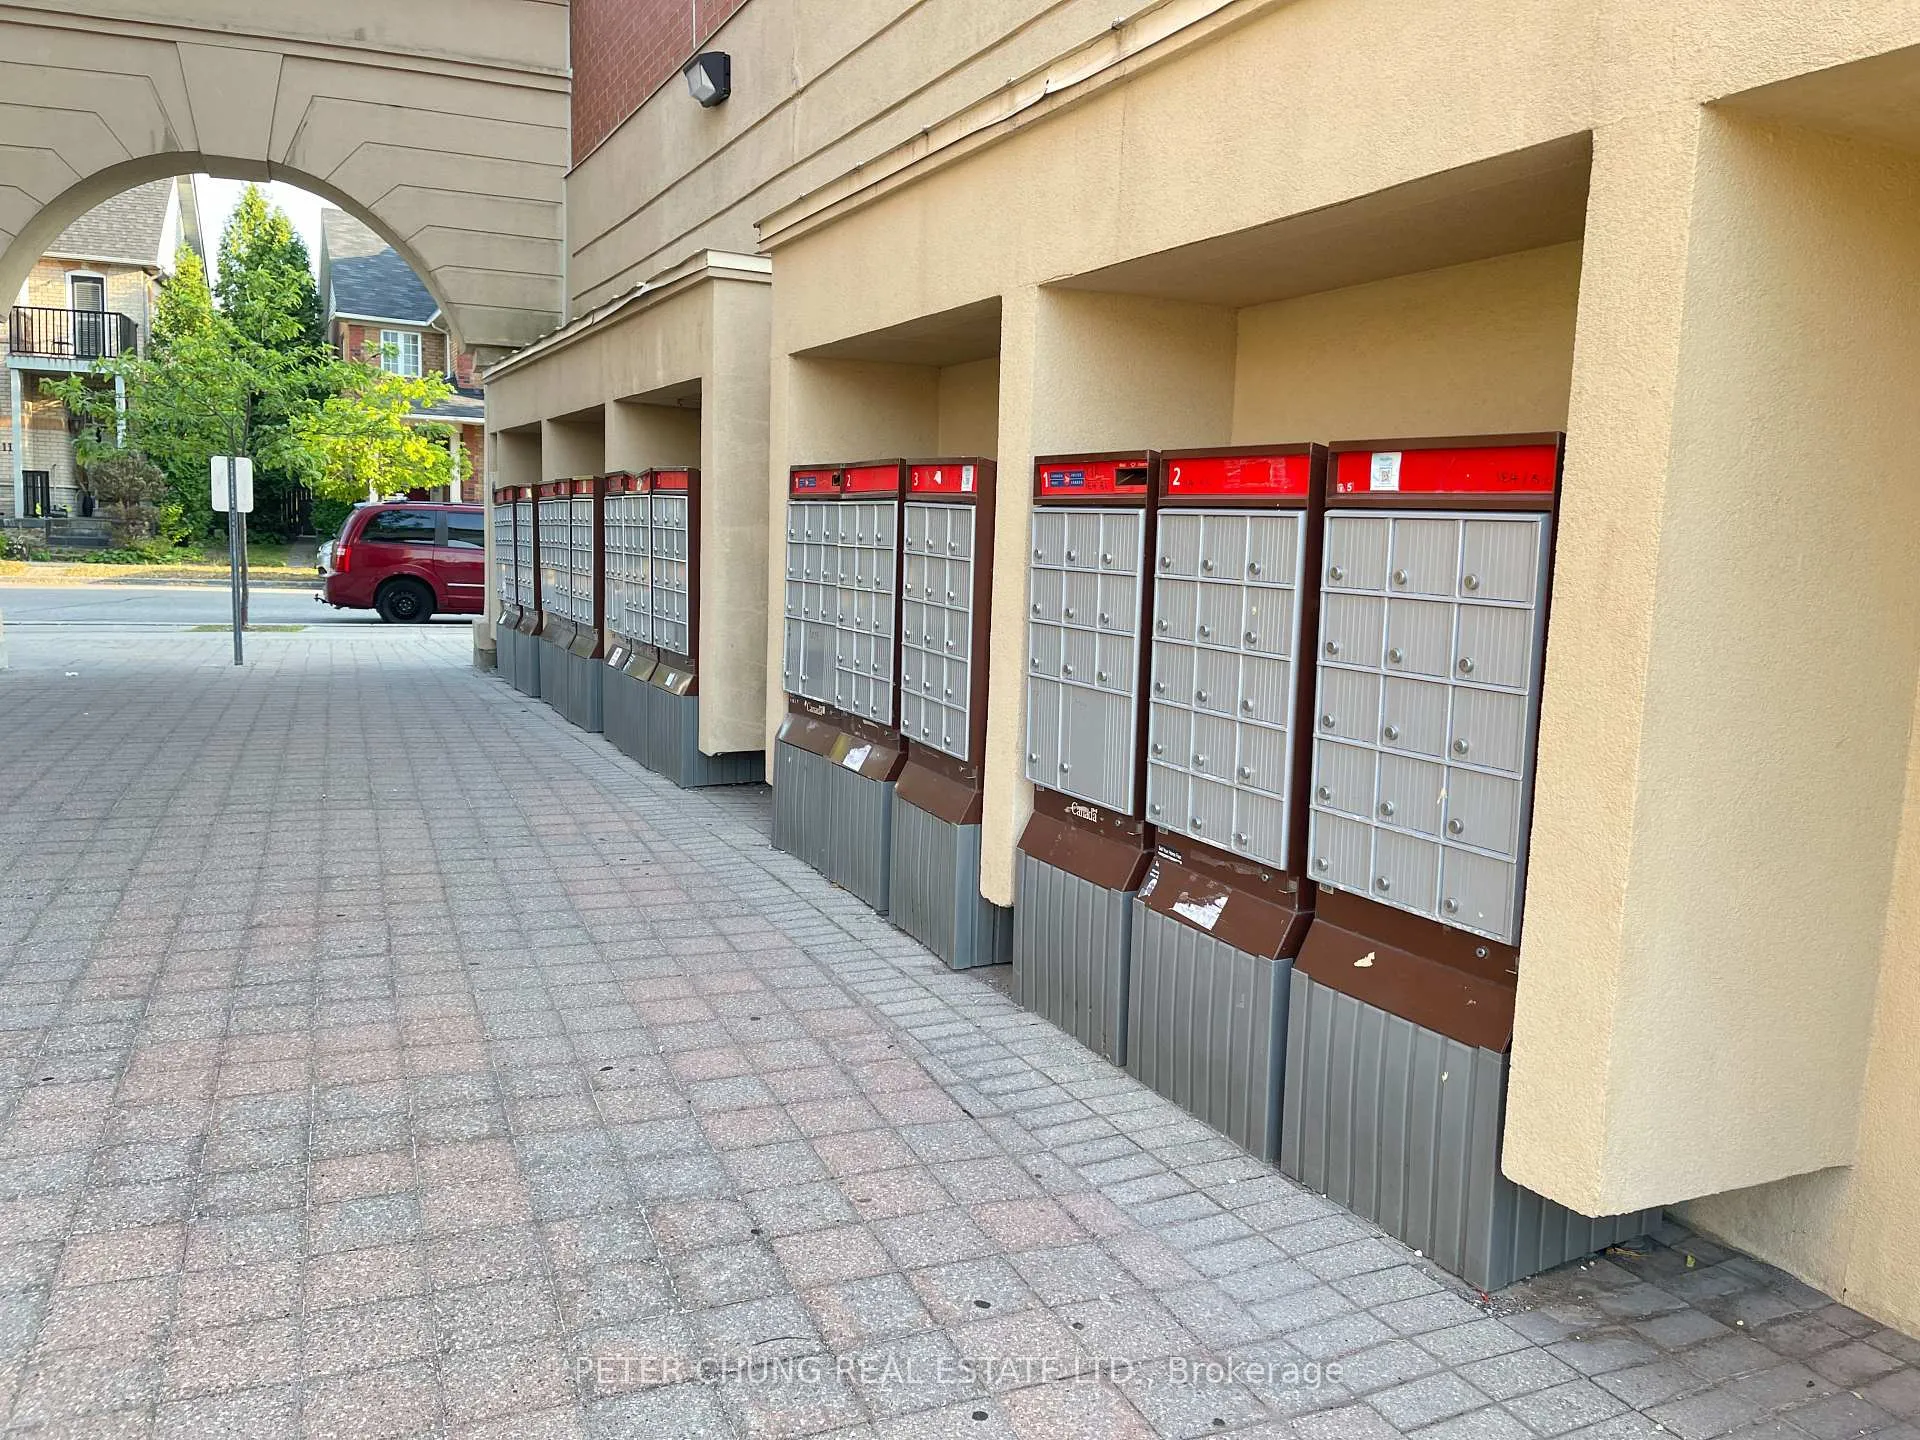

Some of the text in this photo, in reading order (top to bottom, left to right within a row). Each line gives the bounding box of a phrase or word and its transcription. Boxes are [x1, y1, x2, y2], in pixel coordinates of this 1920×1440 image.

[846, 474, 851, 487] 2
[913, 471, 919, 487] 3
[1043, 471, 1049, 488] 1
[1172, 467, 1181, 486] 2
[1071, 802, 1098, 823] Canada
